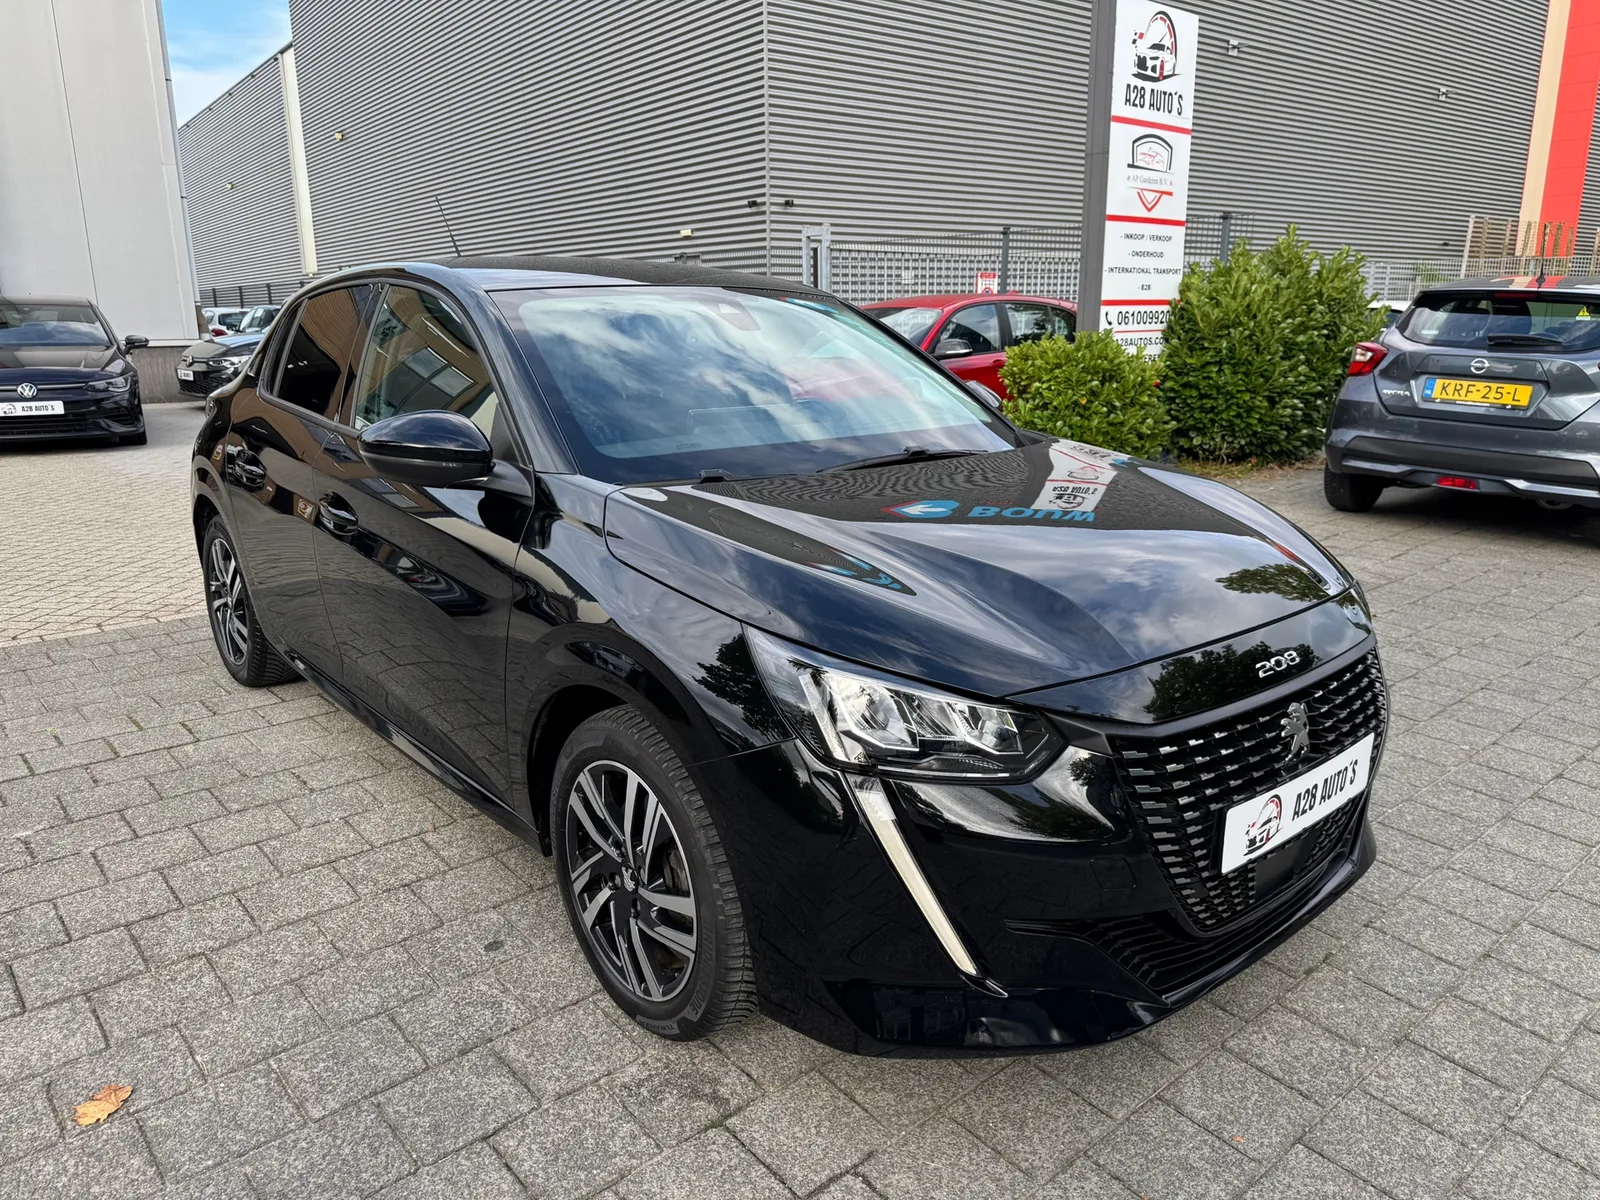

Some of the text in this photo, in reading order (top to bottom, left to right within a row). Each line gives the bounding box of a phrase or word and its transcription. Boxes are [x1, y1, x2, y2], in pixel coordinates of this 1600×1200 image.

[1124, 83, 1146, 109] A28
[1123, 233, 1145, 241] INKOOP
[1149, 234, 1172, 242] VERKOOP
[1131, 250, 1164, 258] ONDERHOUD
[1108, 266, 1151, 274] INTERNATIONAL
[1153, 267, 1181, 275] TRANSPORT
[1117, 310, 1170, 326] 061009920
[1439, 382, 1521, 402] KRF-25-L
[1255, 650, 1301, 679] 208
[1292, 783, 1318, 821] A28
